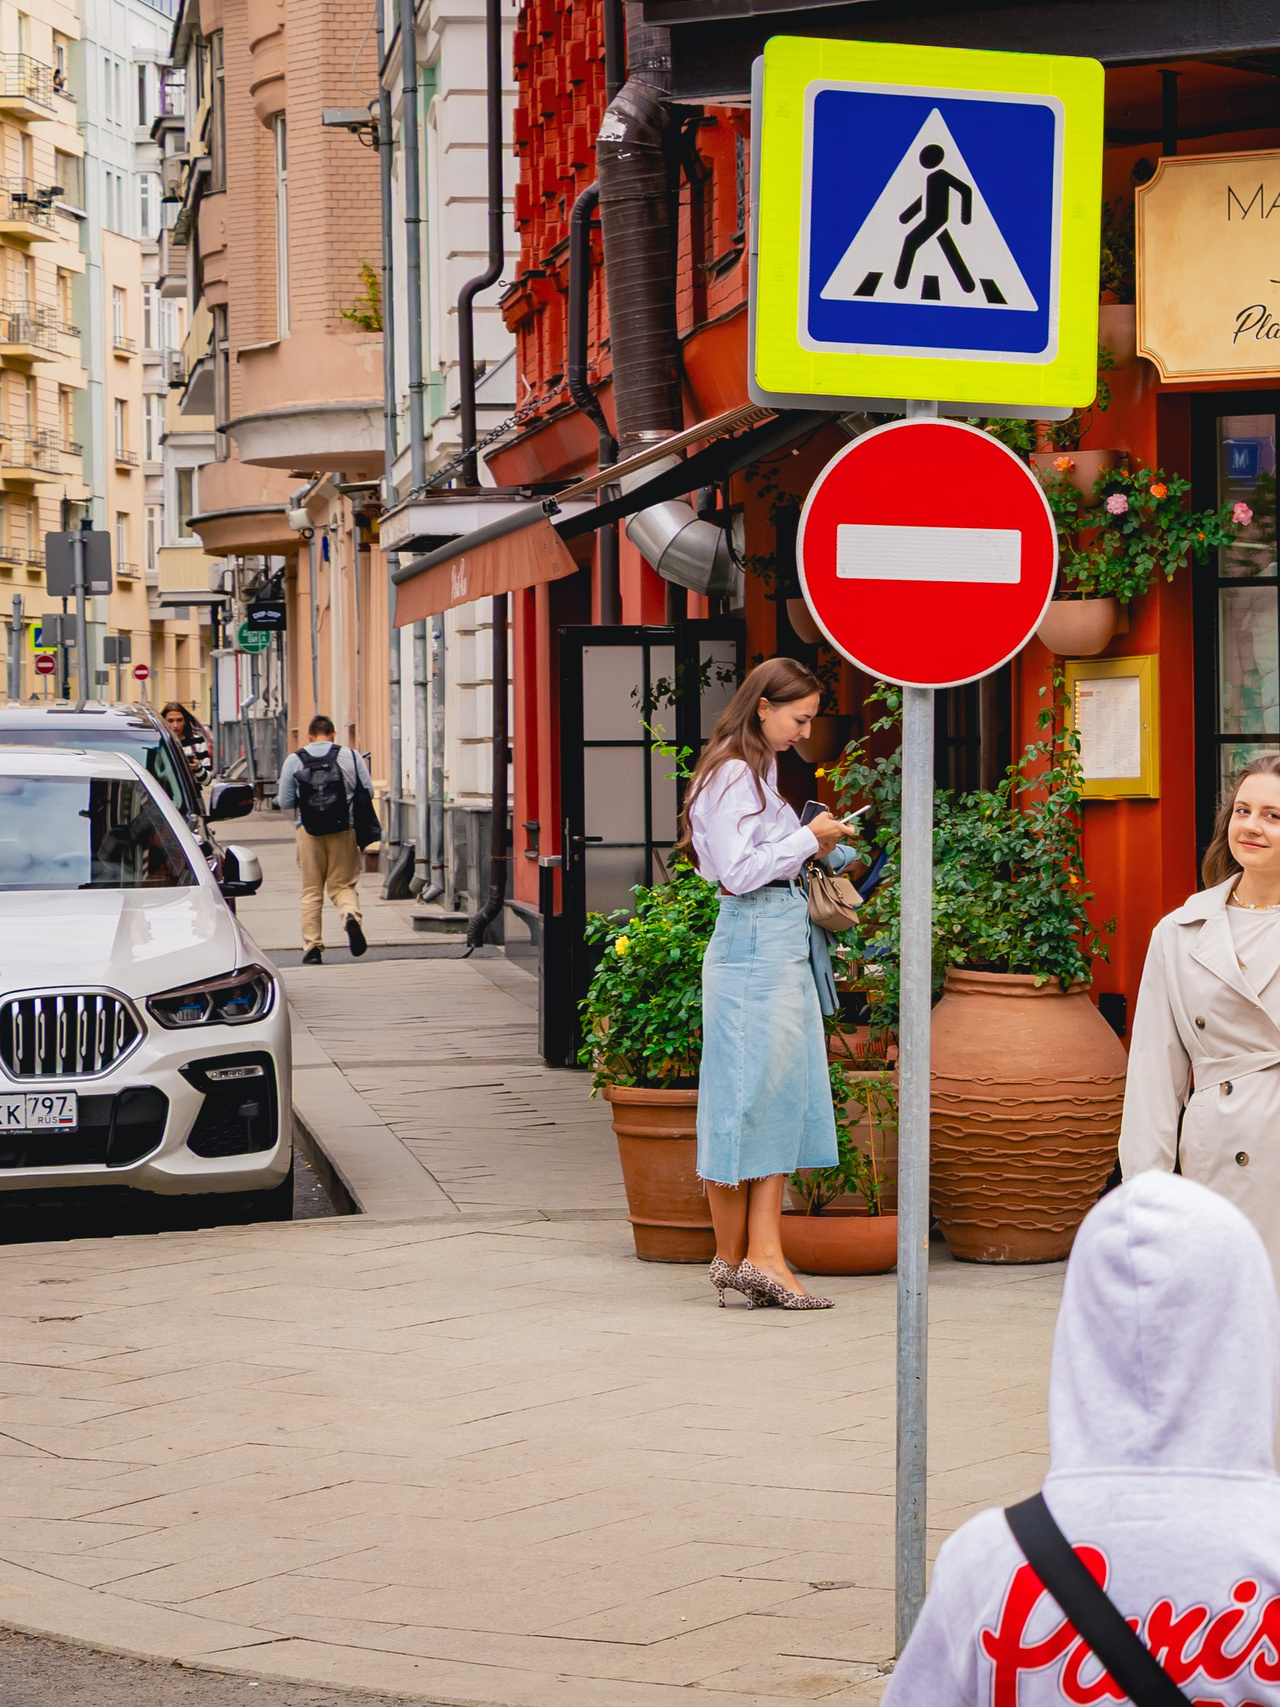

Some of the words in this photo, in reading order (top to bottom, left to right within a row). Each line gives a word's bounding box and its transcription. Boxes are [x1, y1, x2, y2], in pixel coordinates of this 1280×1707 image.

[0, 1104, 21, 1125] K
[28, 1096, 68, 1115] 797
[37, 1116, 58, 1124] RUS
